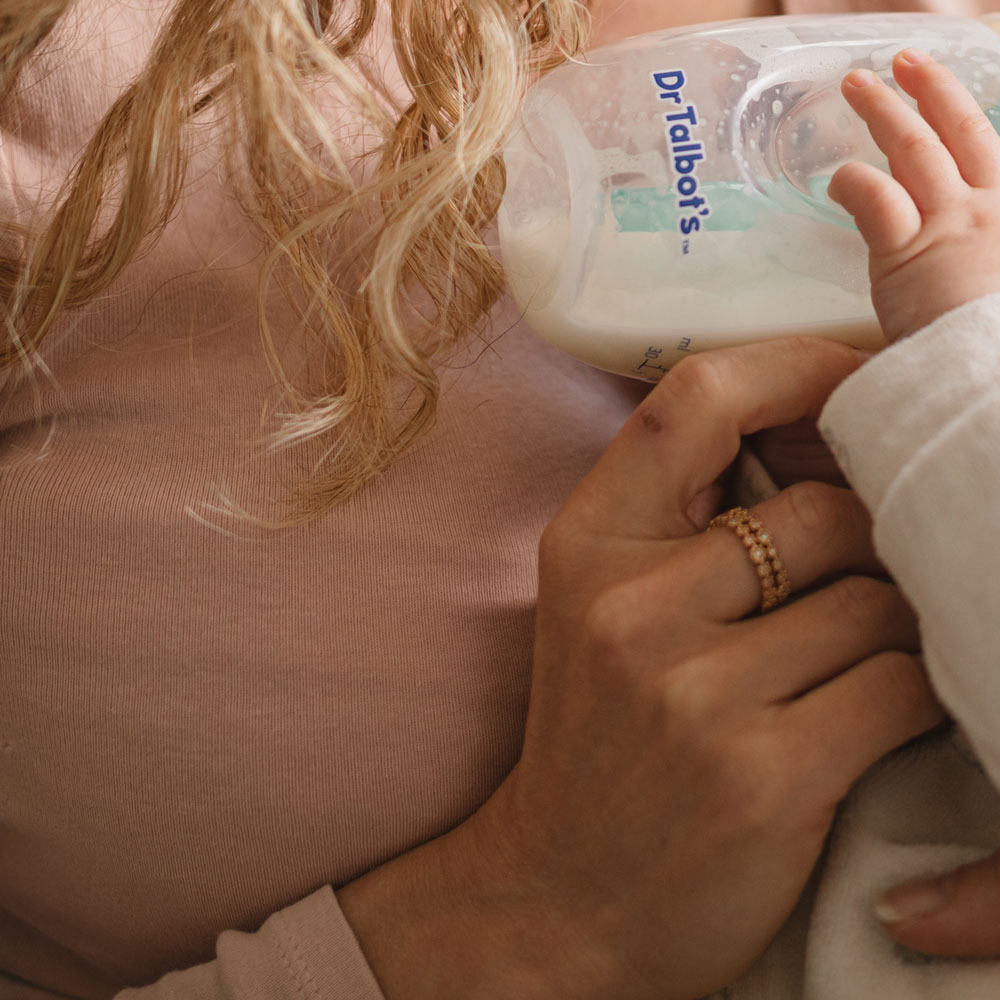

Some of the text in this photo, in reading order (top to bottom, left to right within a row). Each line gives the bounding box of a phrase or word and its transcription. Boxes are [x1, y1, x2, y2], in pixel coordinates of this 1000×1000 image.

[653, 70, 685, 104] Dr
[666, 105, 709, 235] Talbot's
[644, 346, 662, 359] 30
[677, 336, 692, 352] ml
